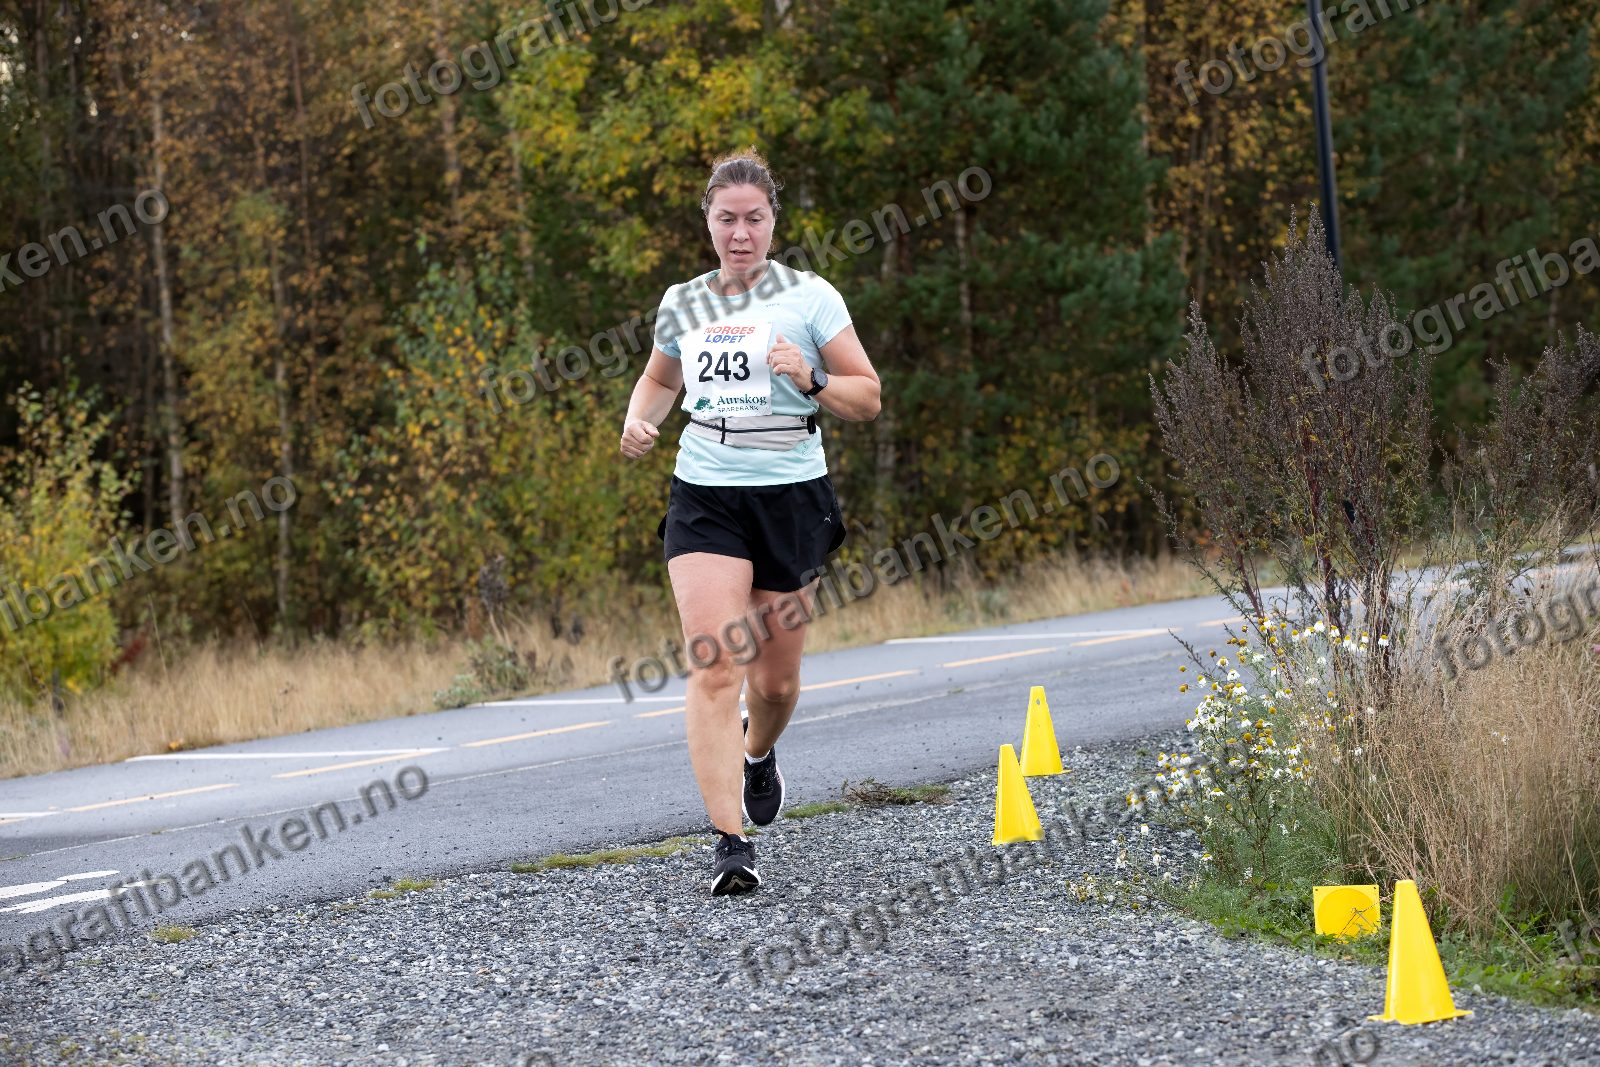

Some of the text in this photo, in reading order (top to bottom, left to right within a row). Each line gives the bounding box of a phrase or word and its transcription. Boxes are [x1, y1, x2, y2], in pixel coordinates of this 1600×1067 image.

[704, 326, 756, 335] NORGES
[705, 334, 746, 344] LØPET
[697, 350, 751, 383] 243
[717, 394, 768, 406] Aurskog
